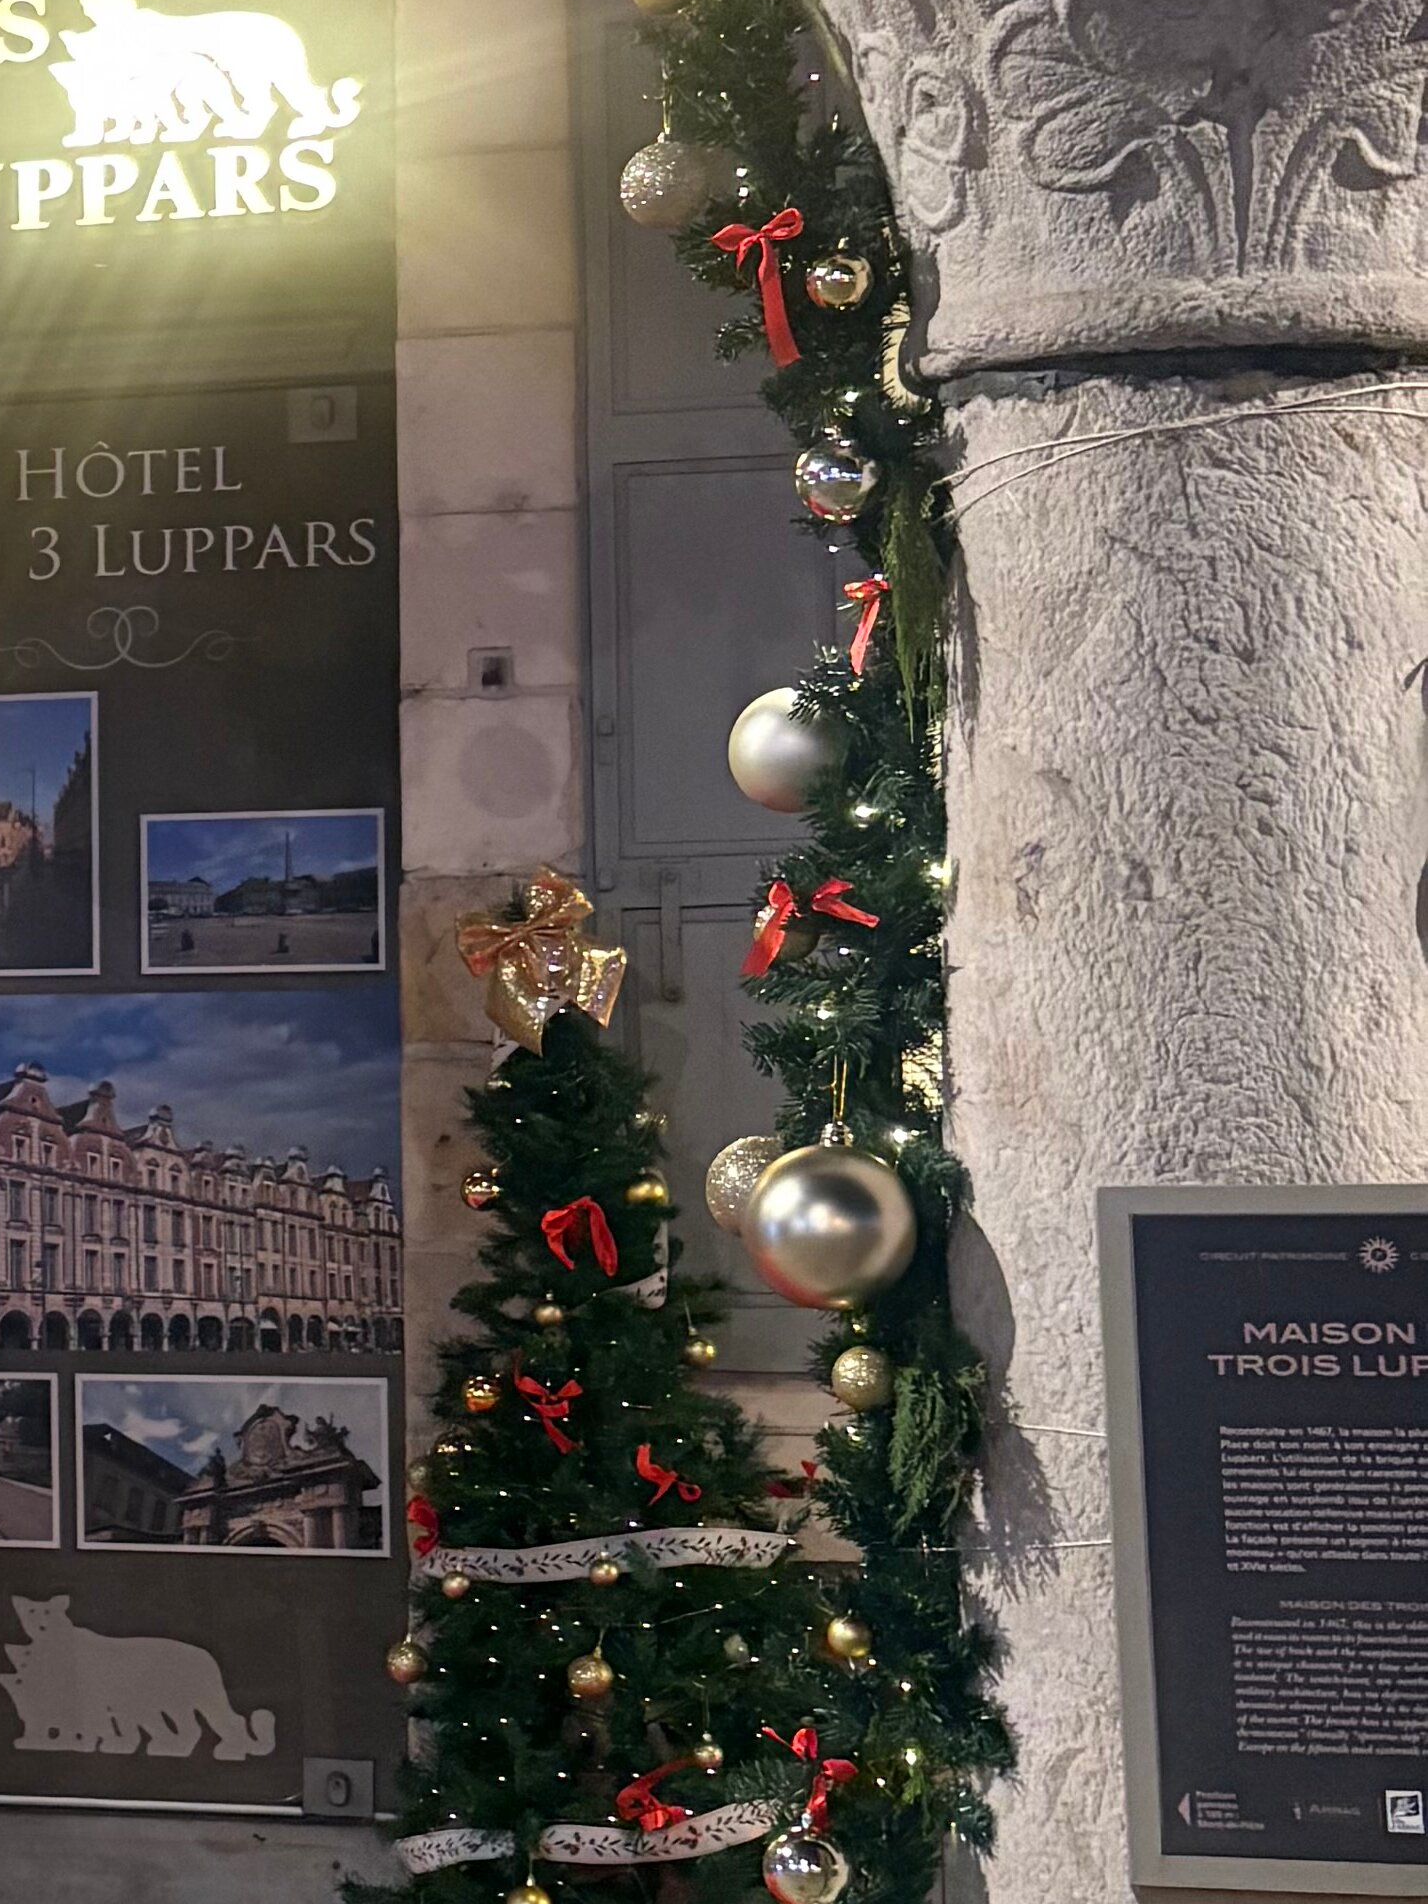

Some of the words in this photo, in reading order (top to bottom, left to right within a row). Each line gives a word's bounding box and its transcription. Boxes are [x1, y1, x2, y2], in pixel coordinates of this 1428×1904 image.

[15, 441, 243, 502] HÔTEL
[28, 526, 62, 580] 3
[93, 517, 377, 577] LUPPARS
[1244, 1322, 1416, 1345] MAISON
[1207, 1354, 1342, 1377] TROIS
